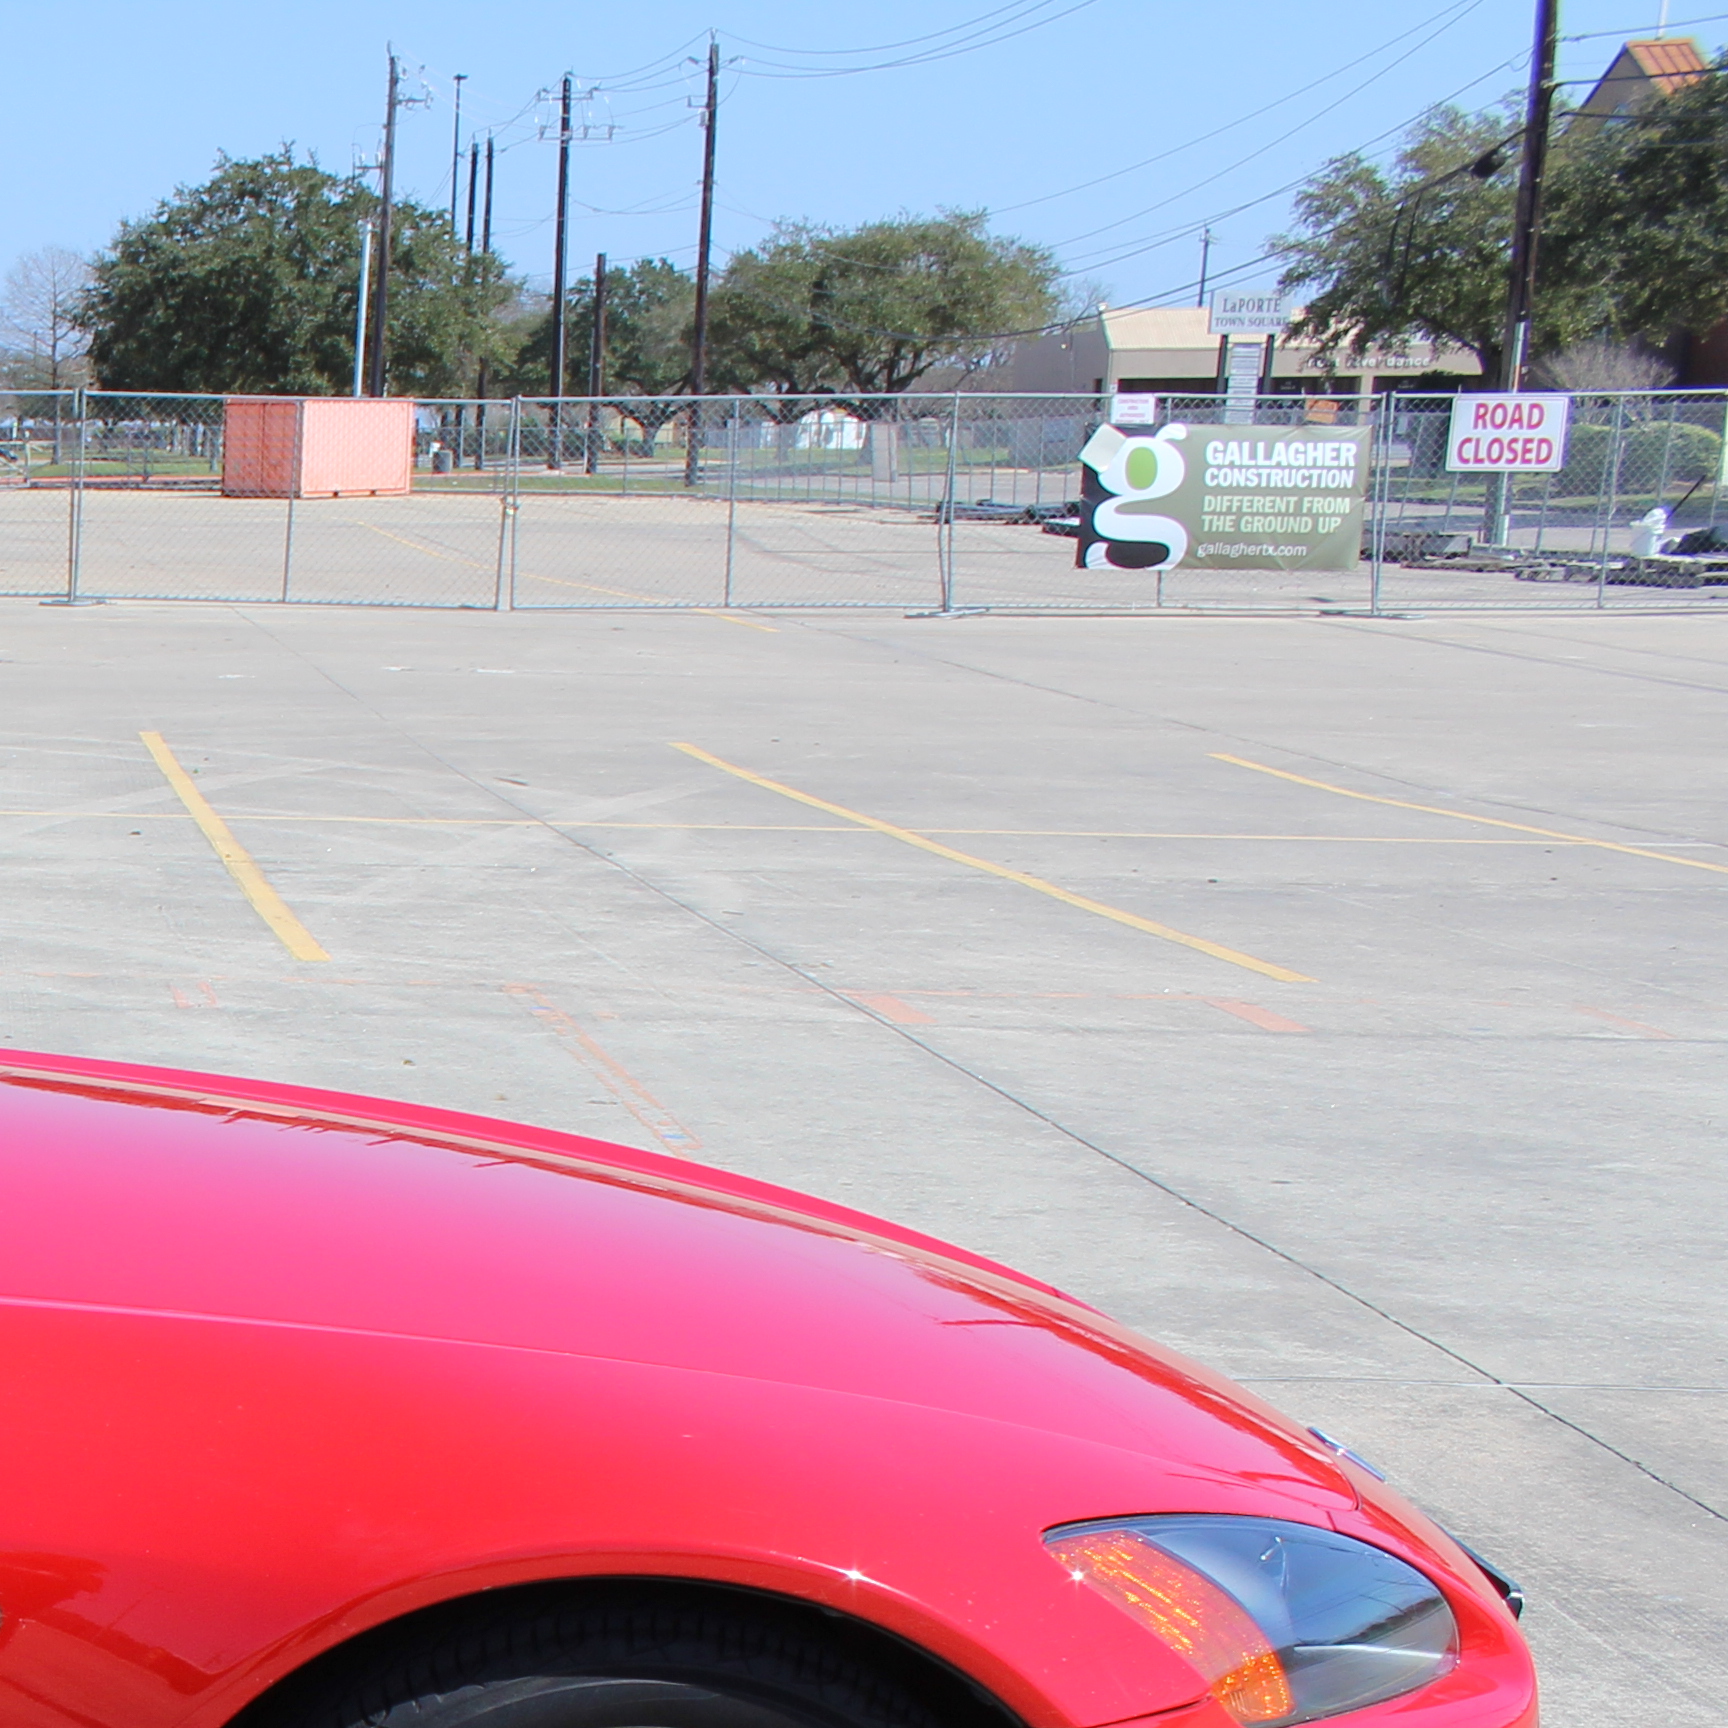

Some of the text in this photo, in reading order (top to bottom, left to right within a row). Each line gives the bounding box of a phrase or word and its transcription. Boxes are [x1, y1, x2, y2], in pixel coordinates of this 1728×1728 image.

[1223, 297, 1282, 313] LaPORTE
[1214, 316, 1245, 328] TOWN
[1386, 355, 1431, 368] dance
[1473, 403, 1545, 430] ROAD
[1205, 440, 1358, 467] GALLAGHER
[1457, 437, 1553, 465] CLOSED
[1204, 467, 1355, 488] CONSTRUCTION
[1202, 494, 1351, 514] DIFFERENT FROM
[1201, 514, 1342, 533] THE GROUND UP
[1196, 541, 1307, 558] gallaghertx.com
